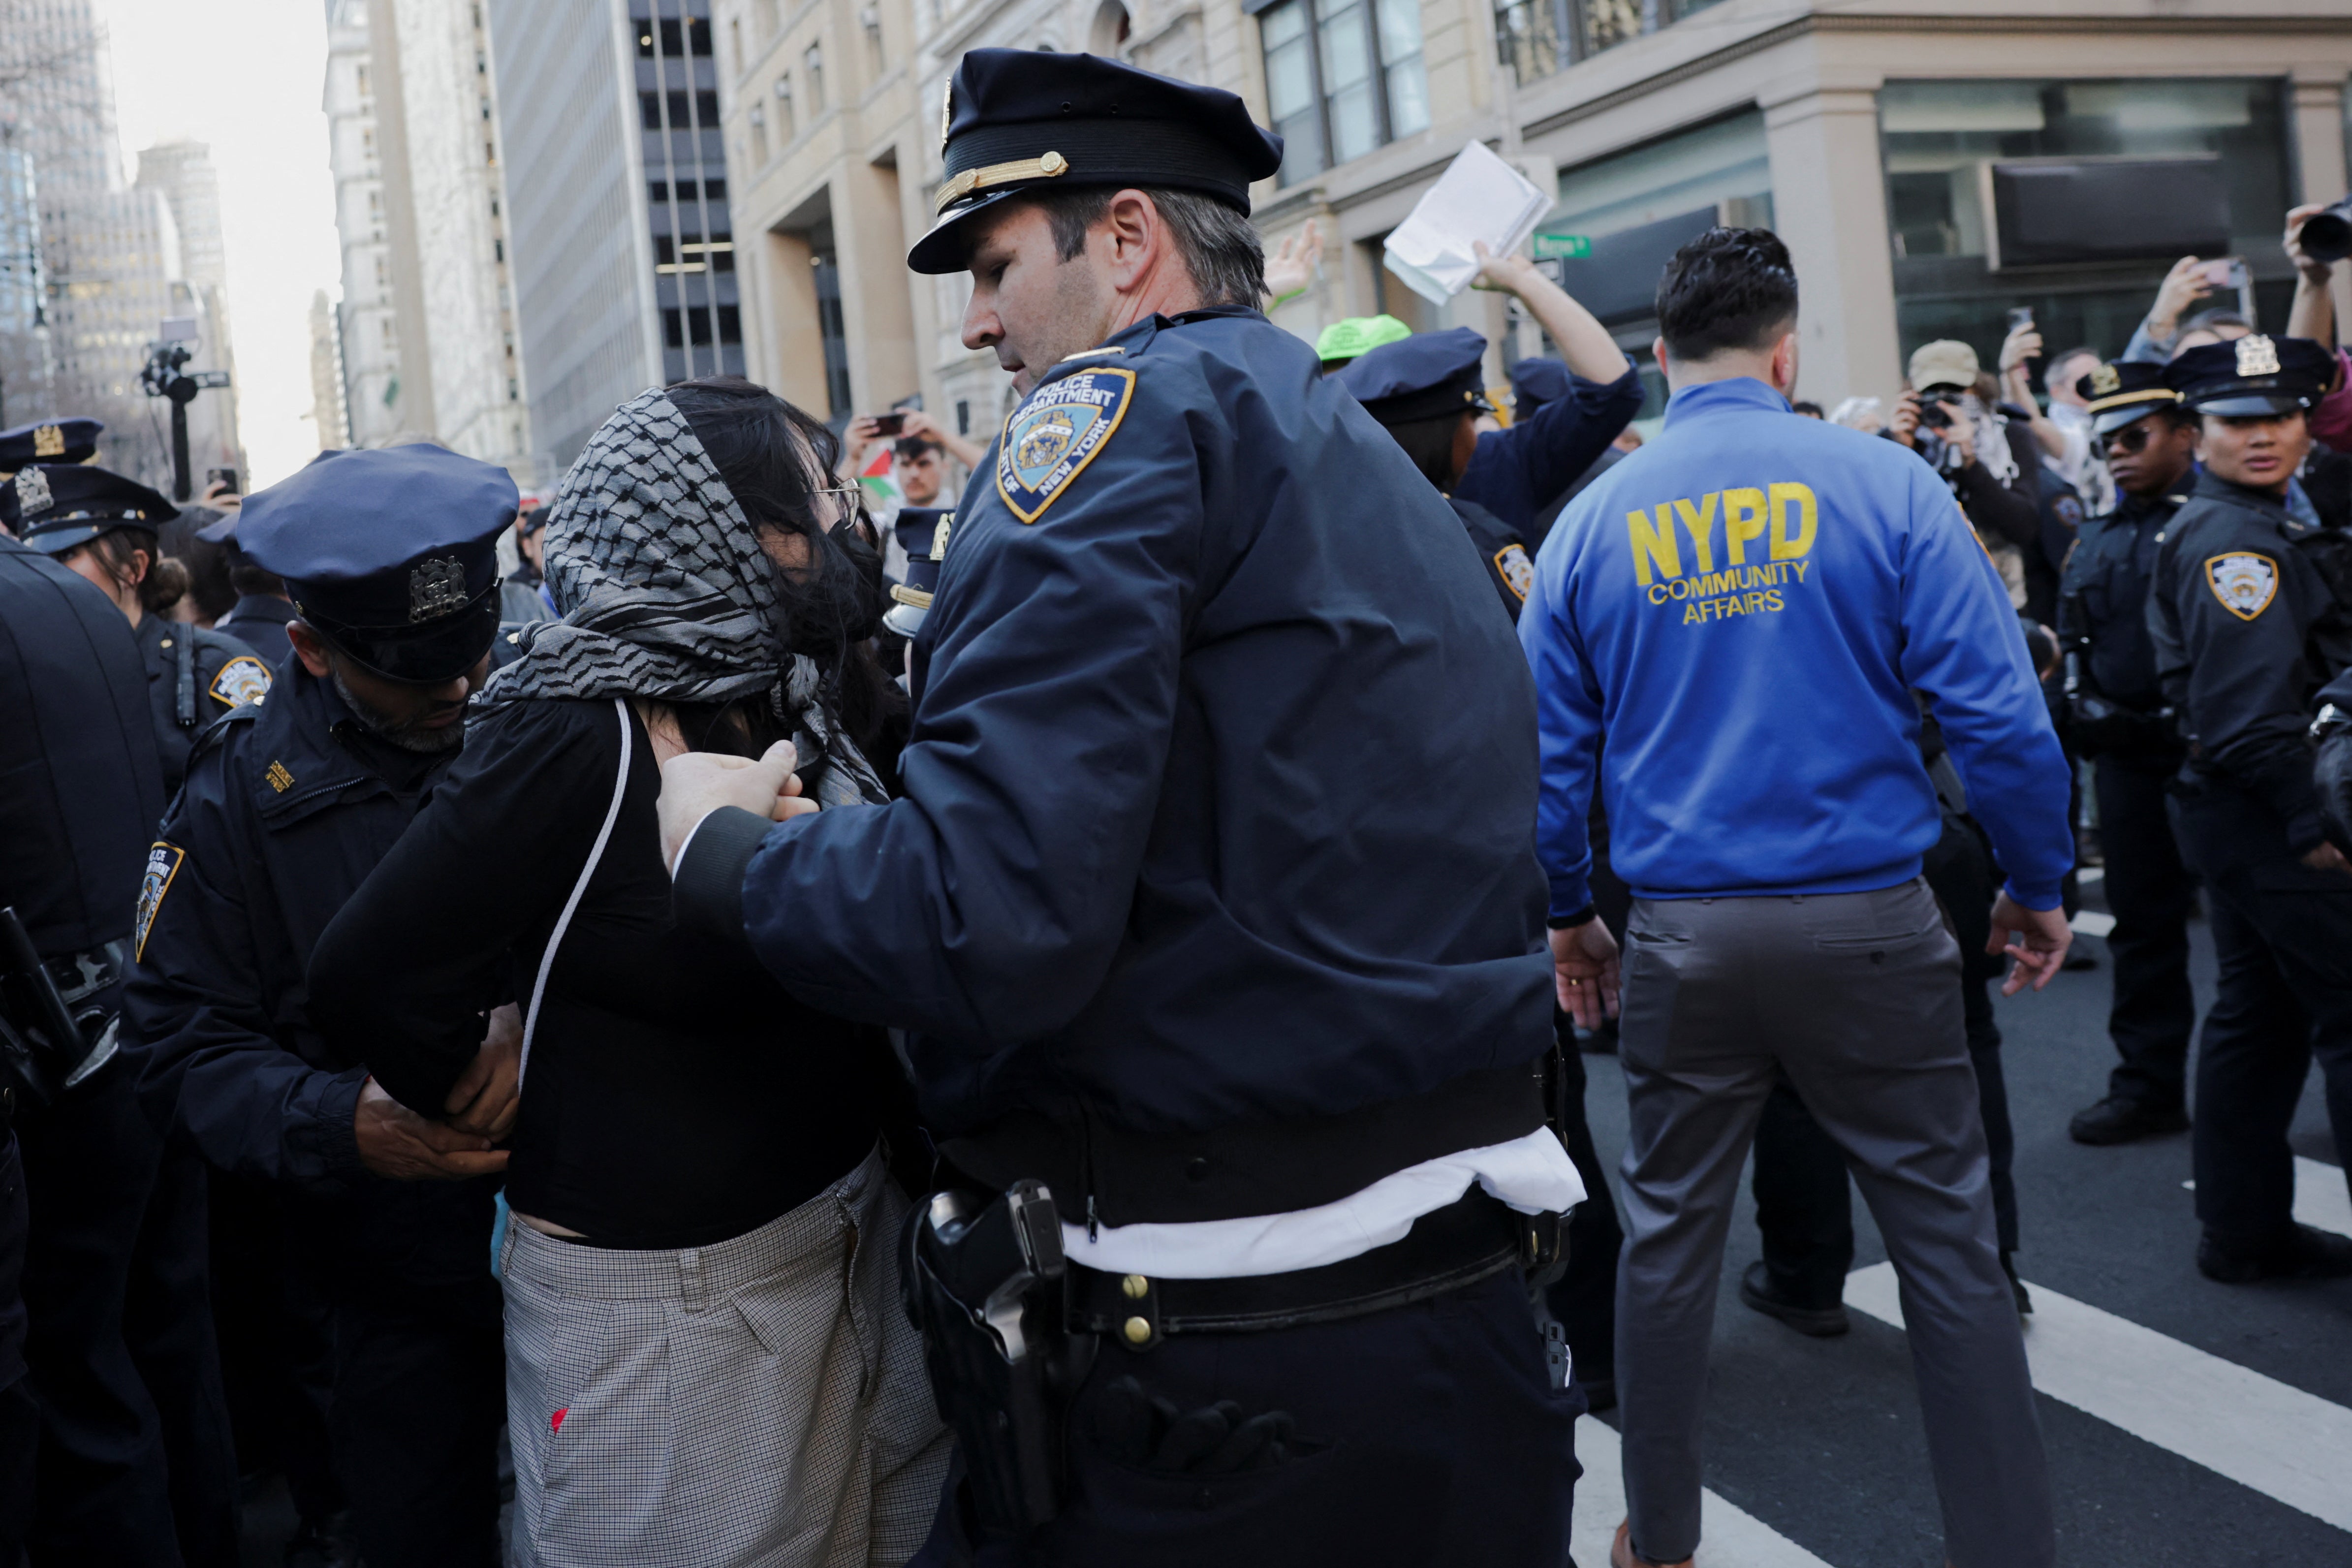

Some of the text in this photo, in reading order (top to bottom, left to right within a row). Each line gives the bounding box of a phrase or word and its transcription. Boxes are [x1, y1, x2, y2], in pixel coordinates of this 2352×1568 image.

[1032, 375, 1095, 401] POLICE
[1008, 388, 1116, 434] DEPARTMENT
[1038, 417, 1111, 496] NEW YORK
[1003, 474, 1021, 493] OF
[1626, 482, 1819, 586] NYPD
[1647, 561, 1810, 605] COMMUNITY
[1682, 589, 1785, 625] AFFAIRS
